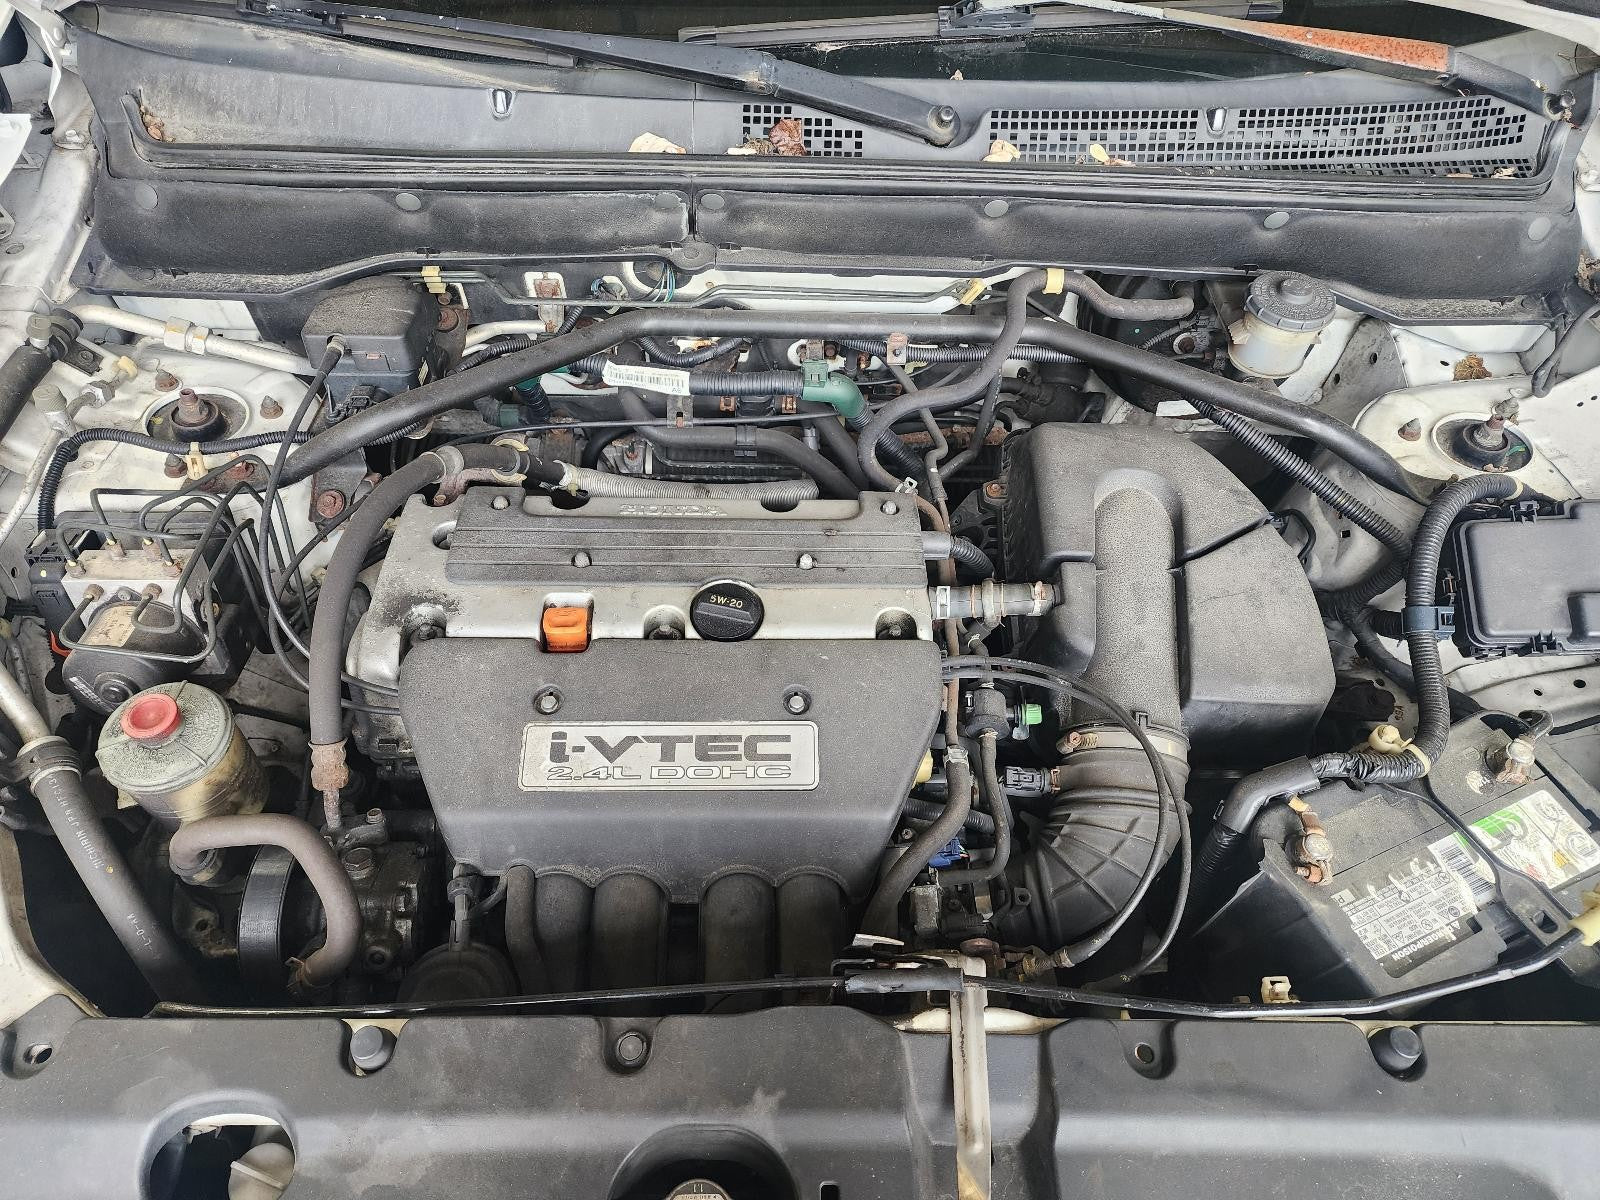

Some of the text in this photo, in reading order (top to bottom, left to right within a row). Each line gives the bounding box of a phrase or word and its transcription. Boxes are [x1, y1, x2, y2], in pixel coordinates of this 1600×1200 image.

[619, 503, 728, 516] HONDA
[710, 594, 743, 609] 5W-20
[550, 731, 792, 764] i-VTEC
[547, 764, 792, 780] 2.4L DOHC
